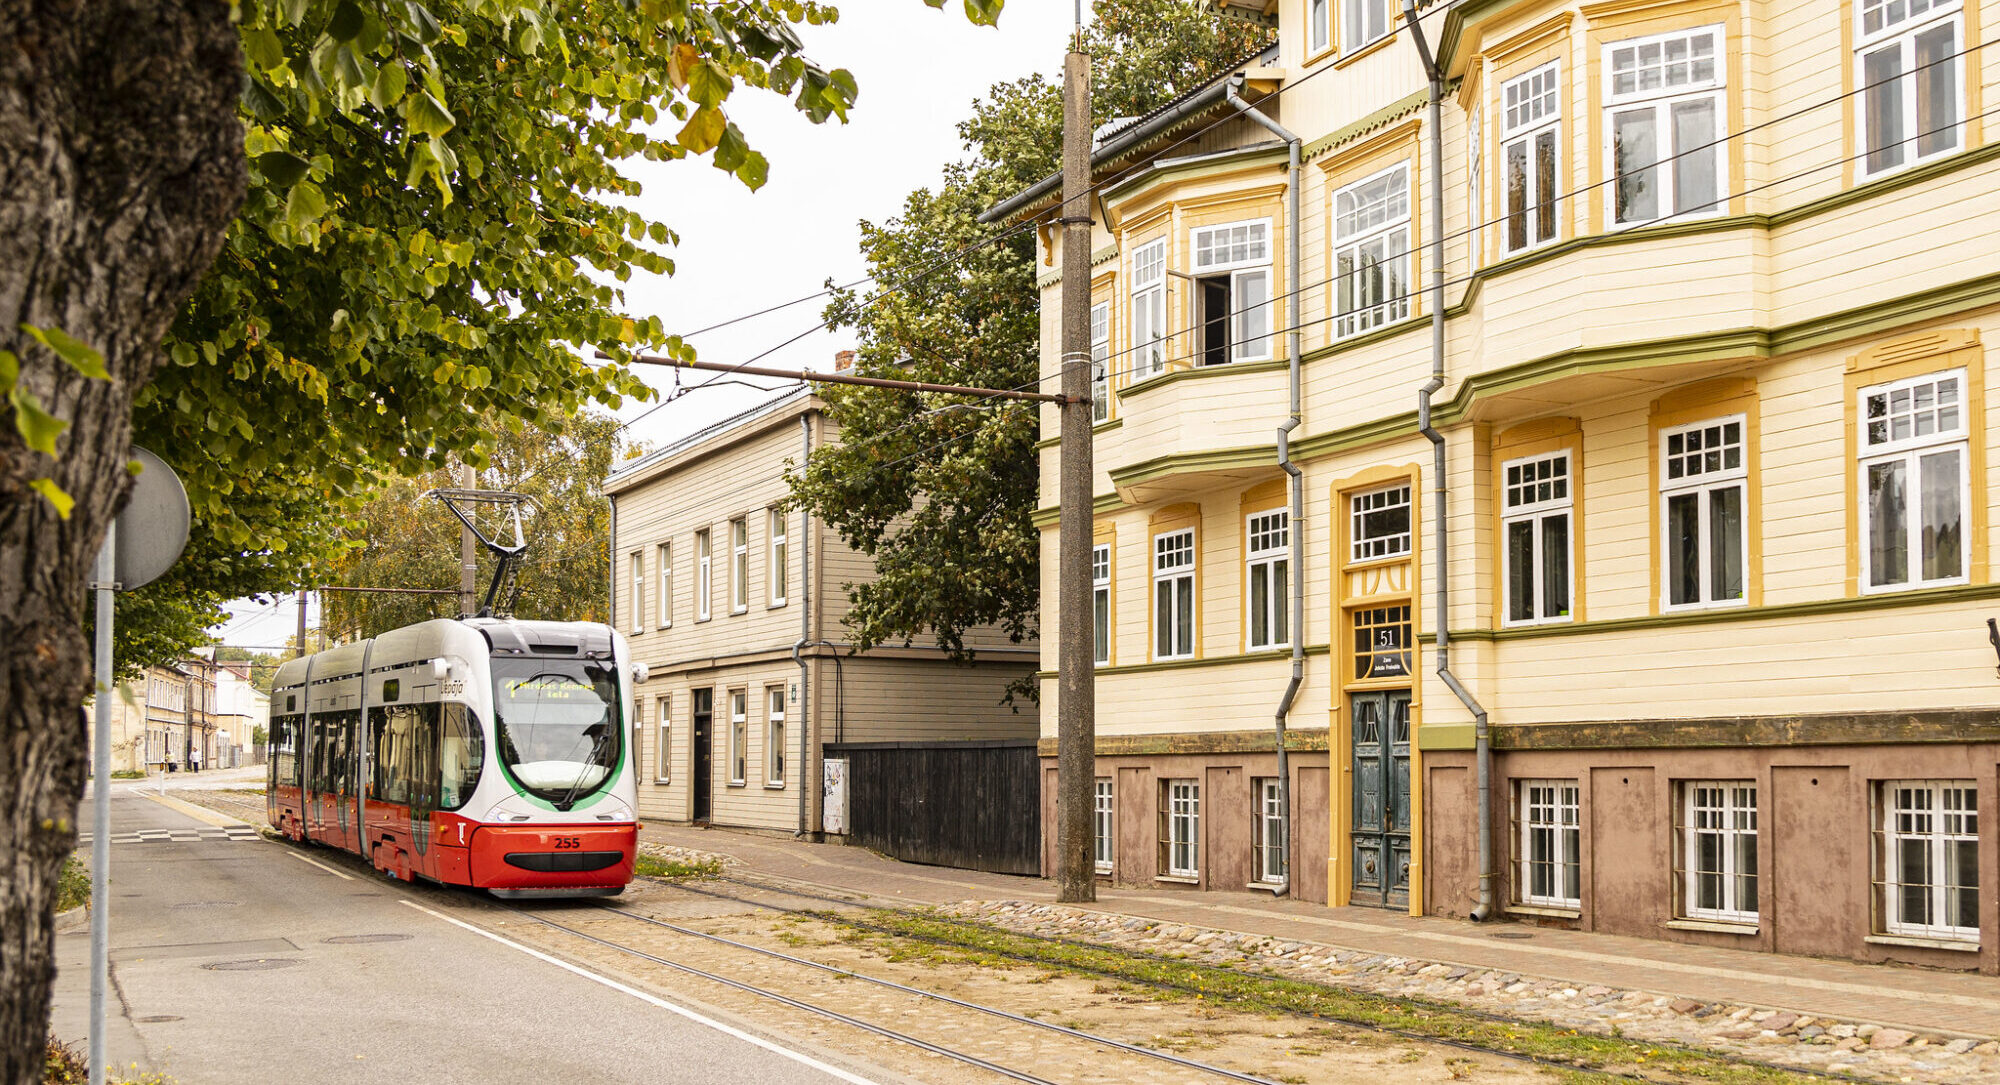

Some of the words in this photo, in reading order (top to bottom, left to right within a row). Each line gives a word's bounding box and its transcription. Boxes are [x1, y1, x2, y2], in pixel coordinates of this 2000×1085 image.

[1380, 630, 1394, 646] 51
[505, 679, 515, 699] 1
[554, 838, 580, 848] 255
